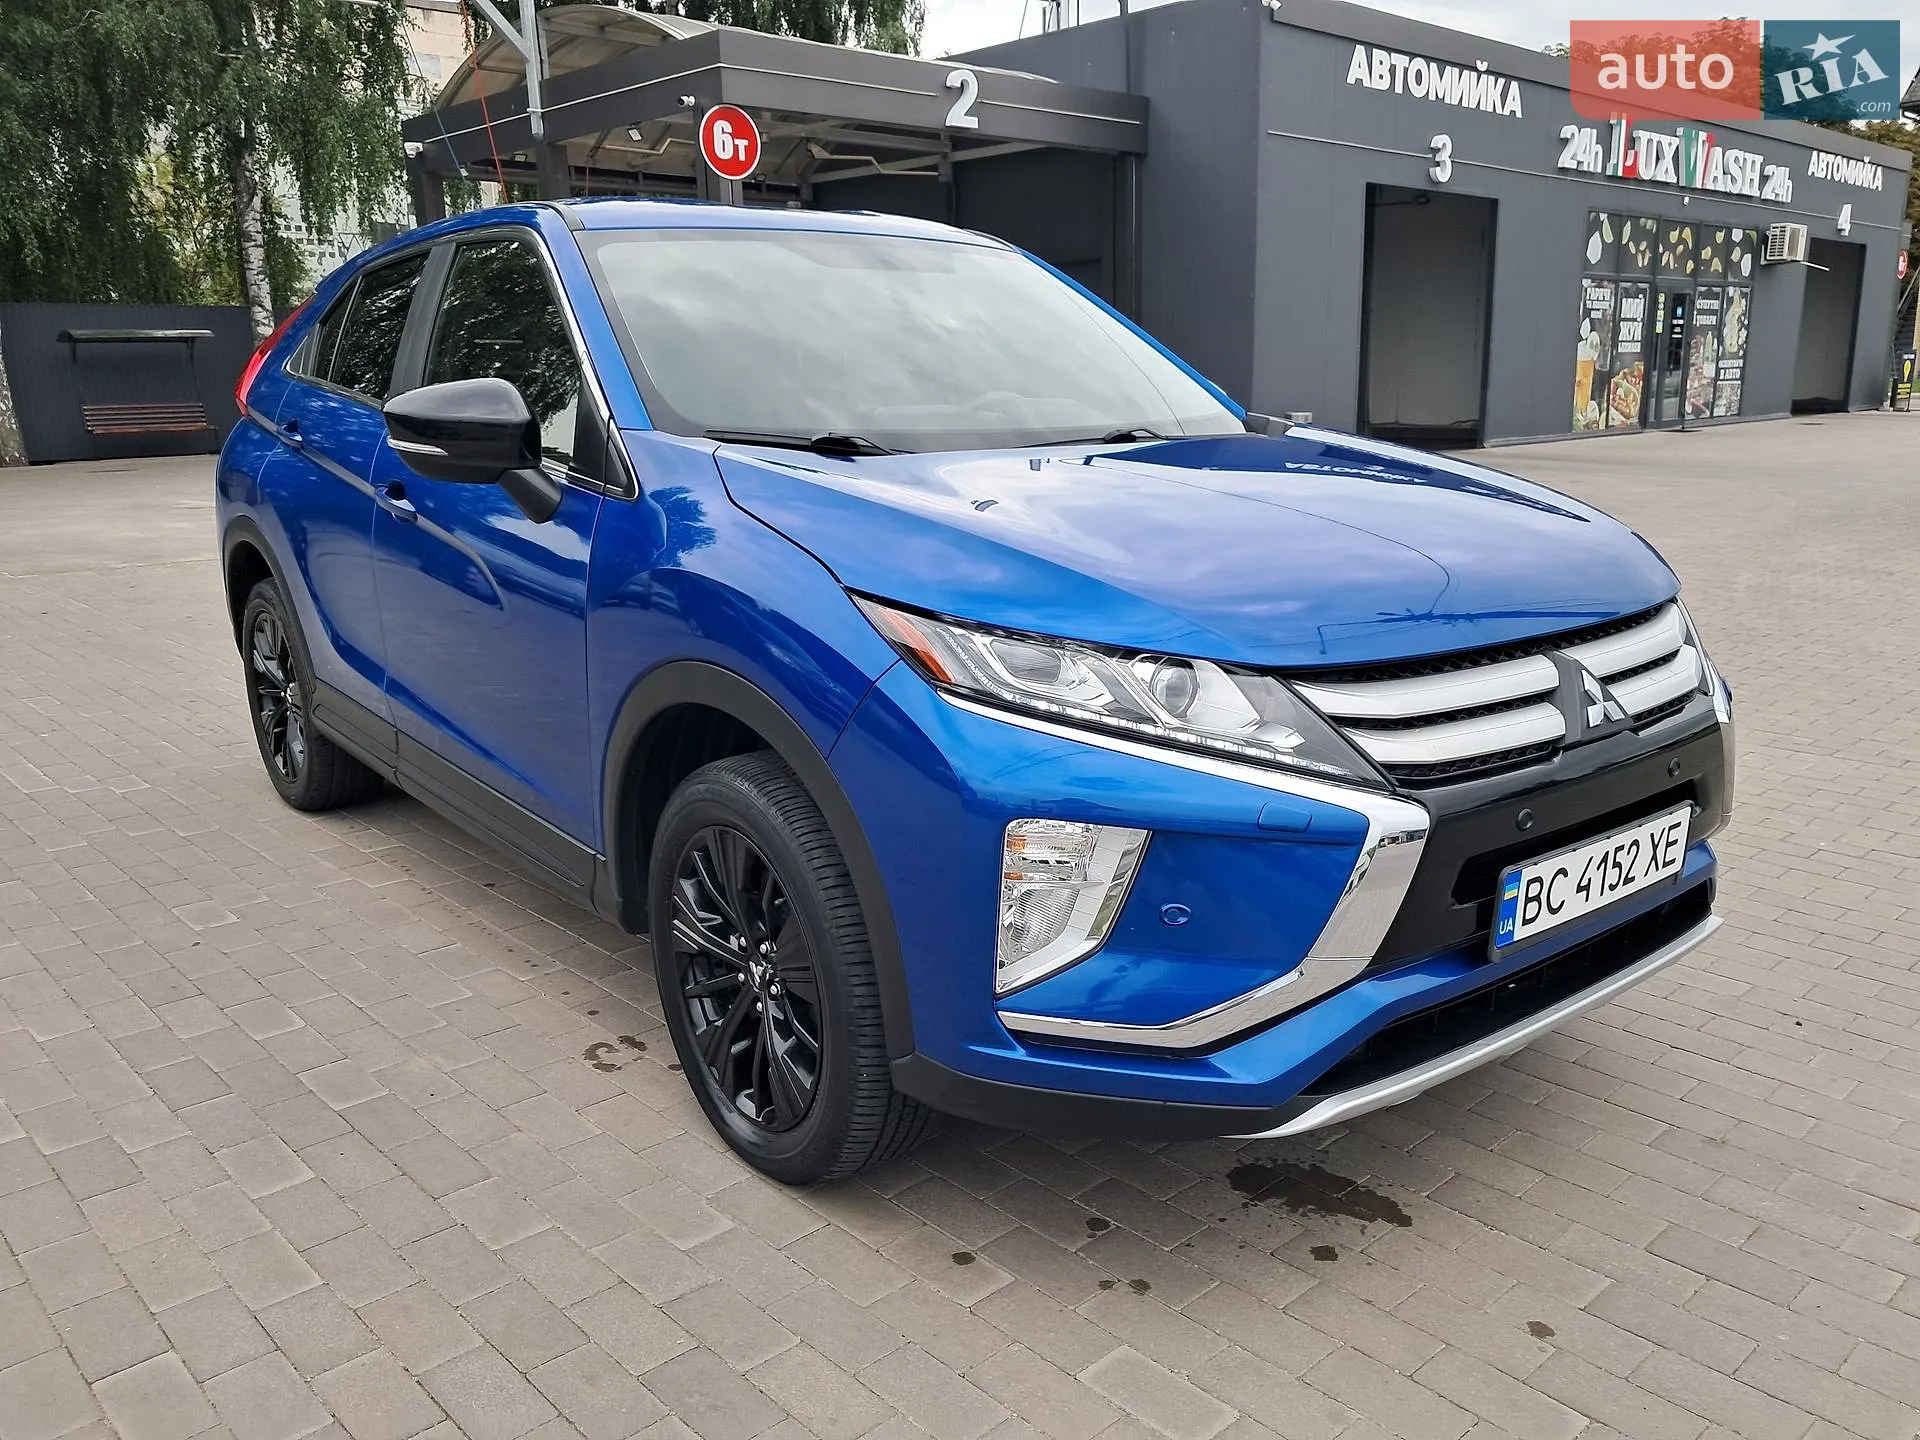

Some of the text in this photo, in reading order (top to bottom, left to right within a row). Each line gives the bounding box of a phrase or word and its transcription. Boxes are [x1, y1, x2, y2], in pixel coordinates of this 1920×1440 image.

[945, 69, 979, 129] 2
[1346, 44, 1523, 119] АВТОМИЙКА
[1428, 133, 1454, 184] 3
[1557, 124, 1604, 174] 24h
[1760, 164, 1794, 204] 24h
[1807, 150, 1884, 192] АВТОМИЙКА
[1836, 203, 1853, 237] 4
[1521, 821, 1682, 926] BC 4152 XE
[1500, 917, 1513, 935] UA
